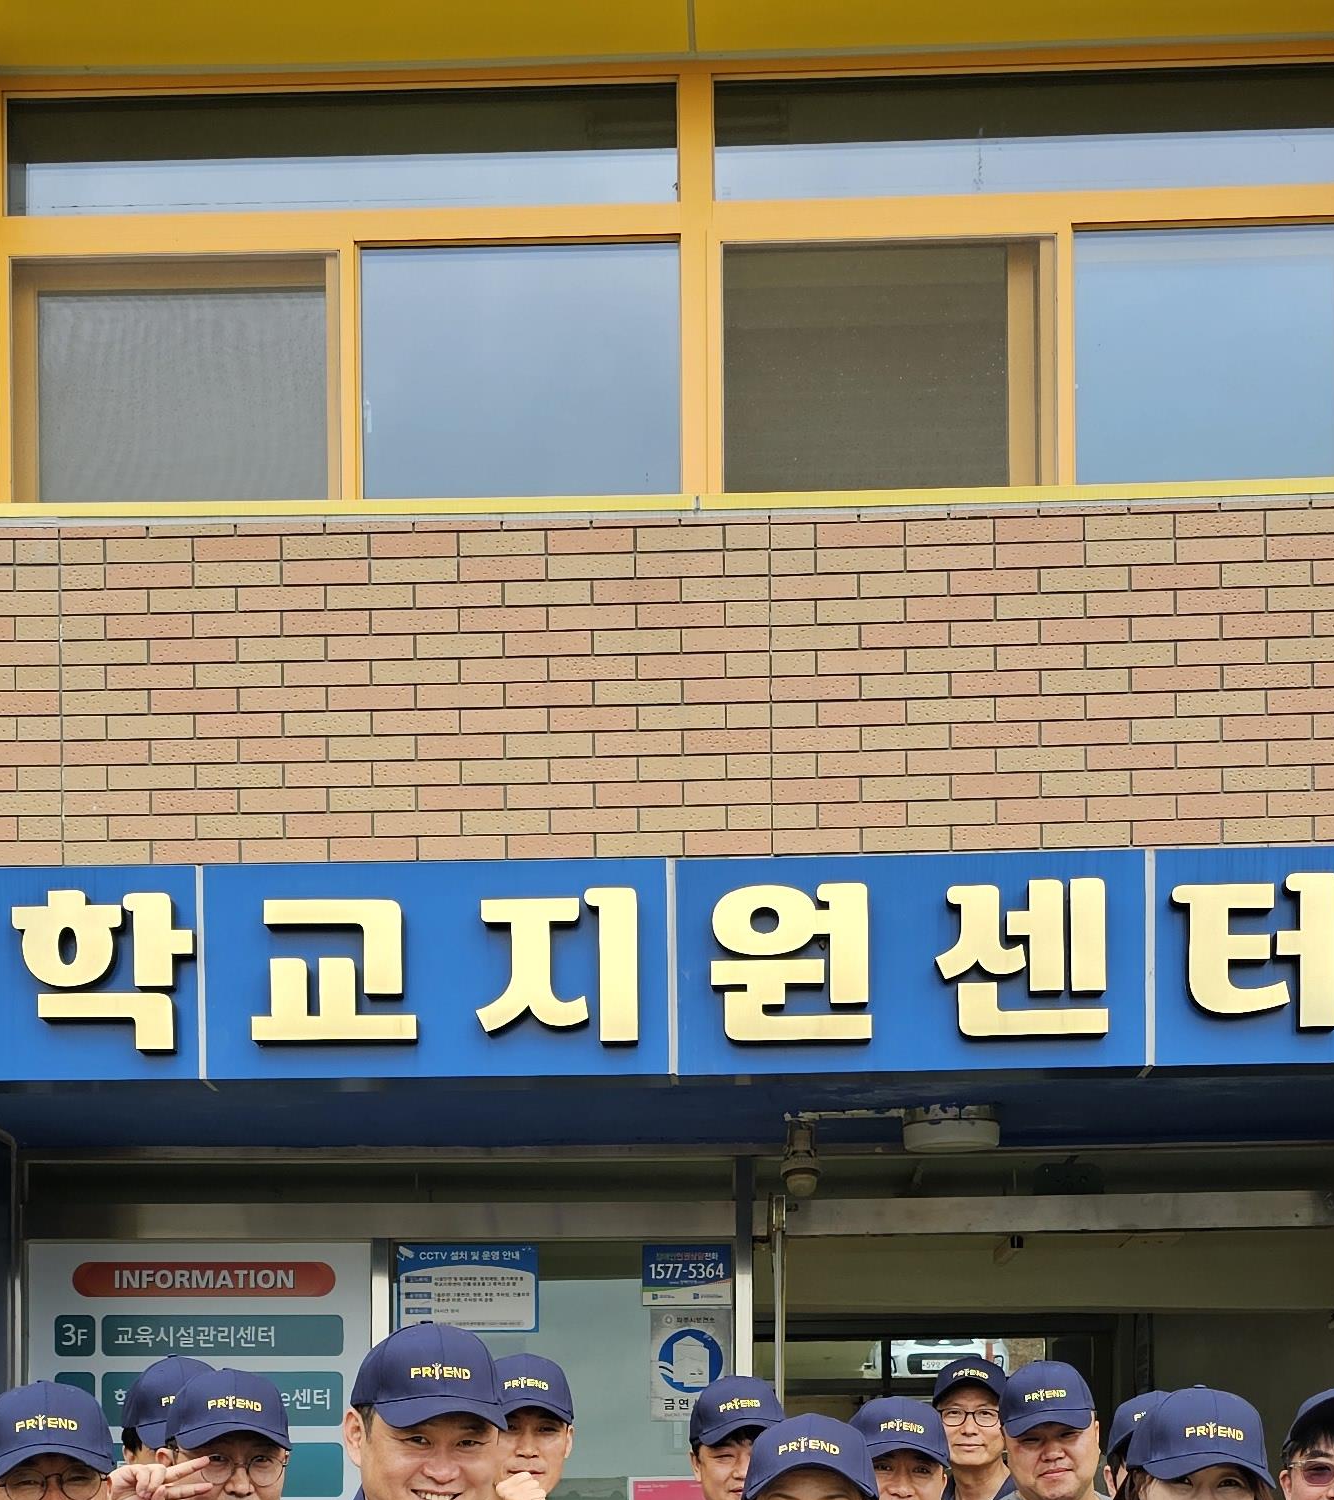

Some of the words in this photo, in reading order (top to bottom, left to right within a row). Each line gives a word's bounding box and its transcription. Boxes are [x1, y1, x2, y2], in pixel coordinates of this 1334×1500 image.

[419, 1251, 447, 1261] CCTV
[450, 1250, 468, 1261] 설치
[482, 1250, 499, 1261] 운영
[502, 1250, 520, 1261] 안내
[114, 1268, 295, 1290] INFORMATION
[649, 1263, 725, 1279] 1577-5364
[61, 1324, 88, 1347] 3F
[114, 1325, 276, 1348] 교육시설관리센터
[410, 1362, 471, 1381] FRIEND
[503, 1376, 549, 1391] FRIEND
[207, 1395, 262, 1412] FRIEND
[280, 1388, 331, 1410] e센터
[664, 1398, 690, 1411] 금연
[1024, 1388, 1067, 1403] FRIEND
[718, 1397, 761, 1413] FRIEND
[15, 1413, 78, 1433] FRIEND
[880, 1418, 925, 1434] FRIEND
[1185, 1421, 1244, 1441] FRIEND
[778, 1436, 840, 1456] FRIEND
